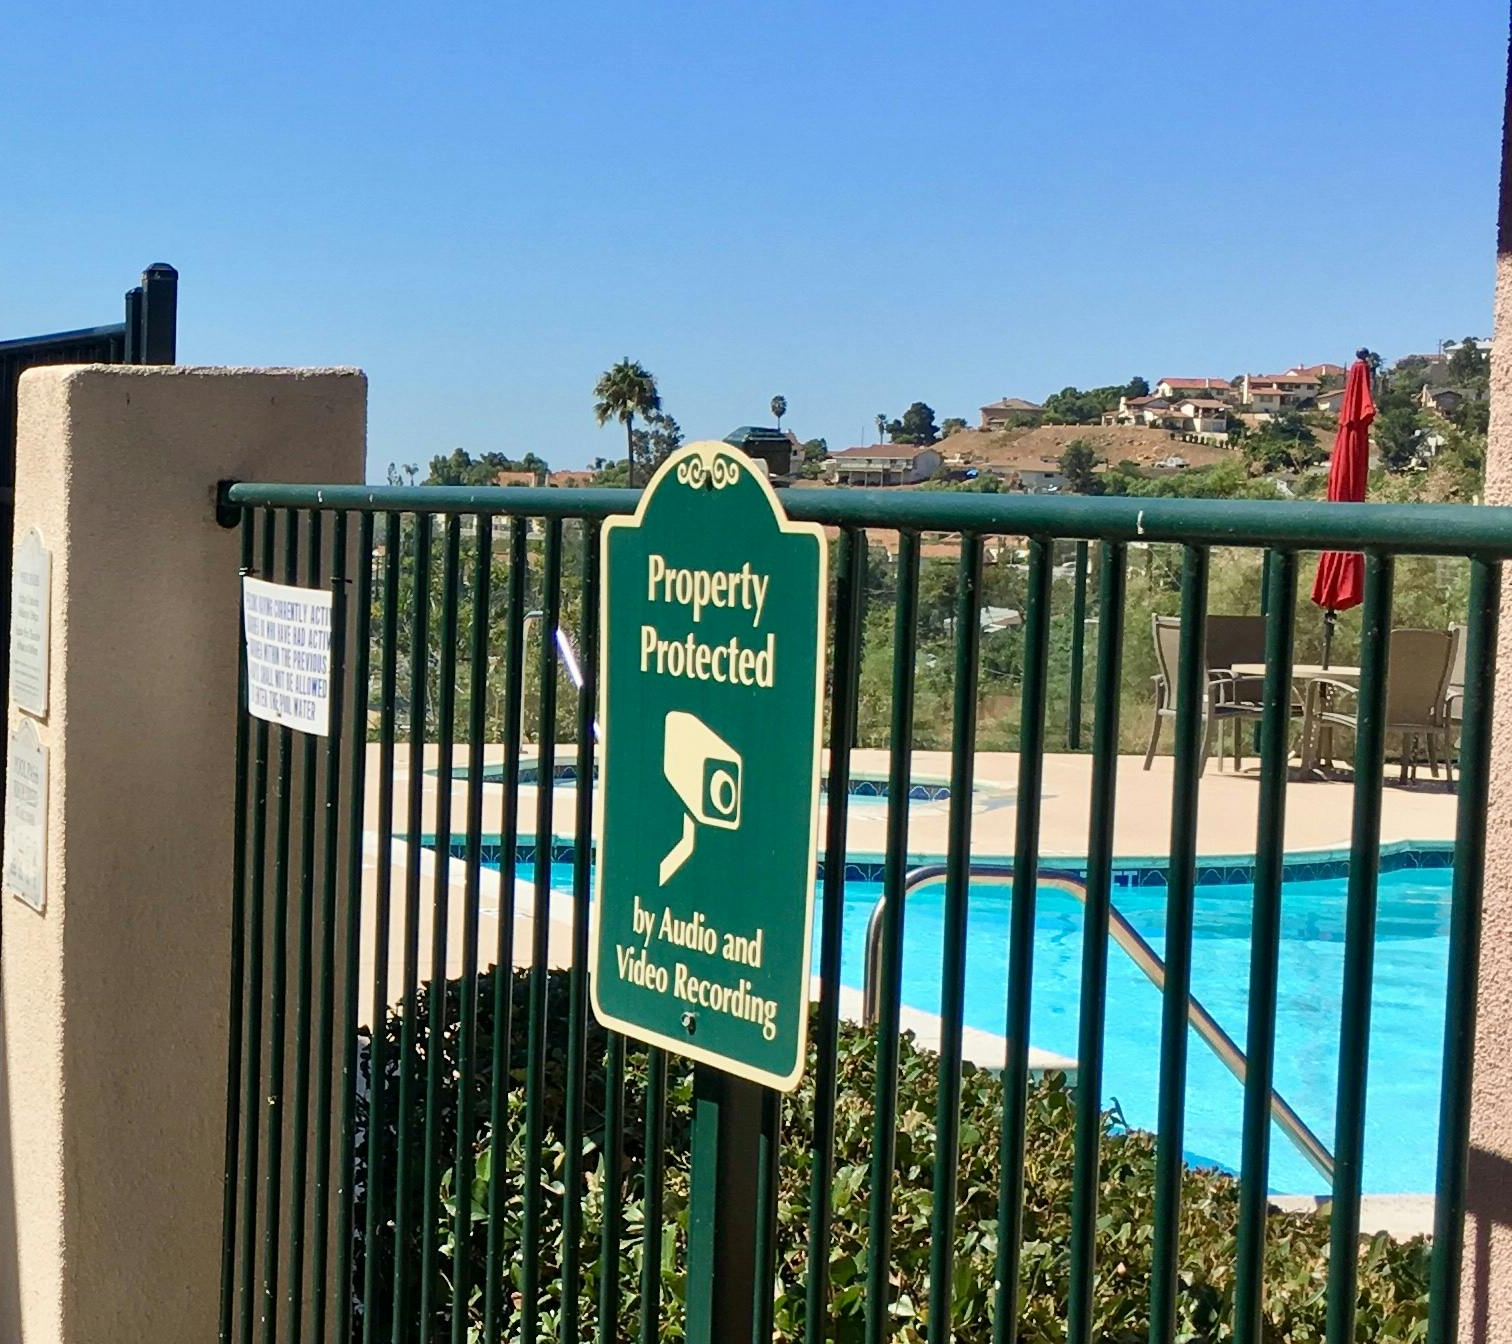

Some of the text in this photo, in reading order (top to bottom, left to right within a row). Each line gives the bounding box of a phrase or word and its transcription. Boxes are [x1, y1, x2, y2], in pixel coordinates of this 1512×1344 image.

[311, 606, 331, 626] ACTI
[648, 554, 769, 628] Property
[292, 650, 328, 674] PREVIOUS
[295, 674, 328, 698] ALLOWED
[640, 625, 775, 688] Protected
[632, 895, 763, 968] by Audio and
[616, 944, 778, 1041] Video Recording
